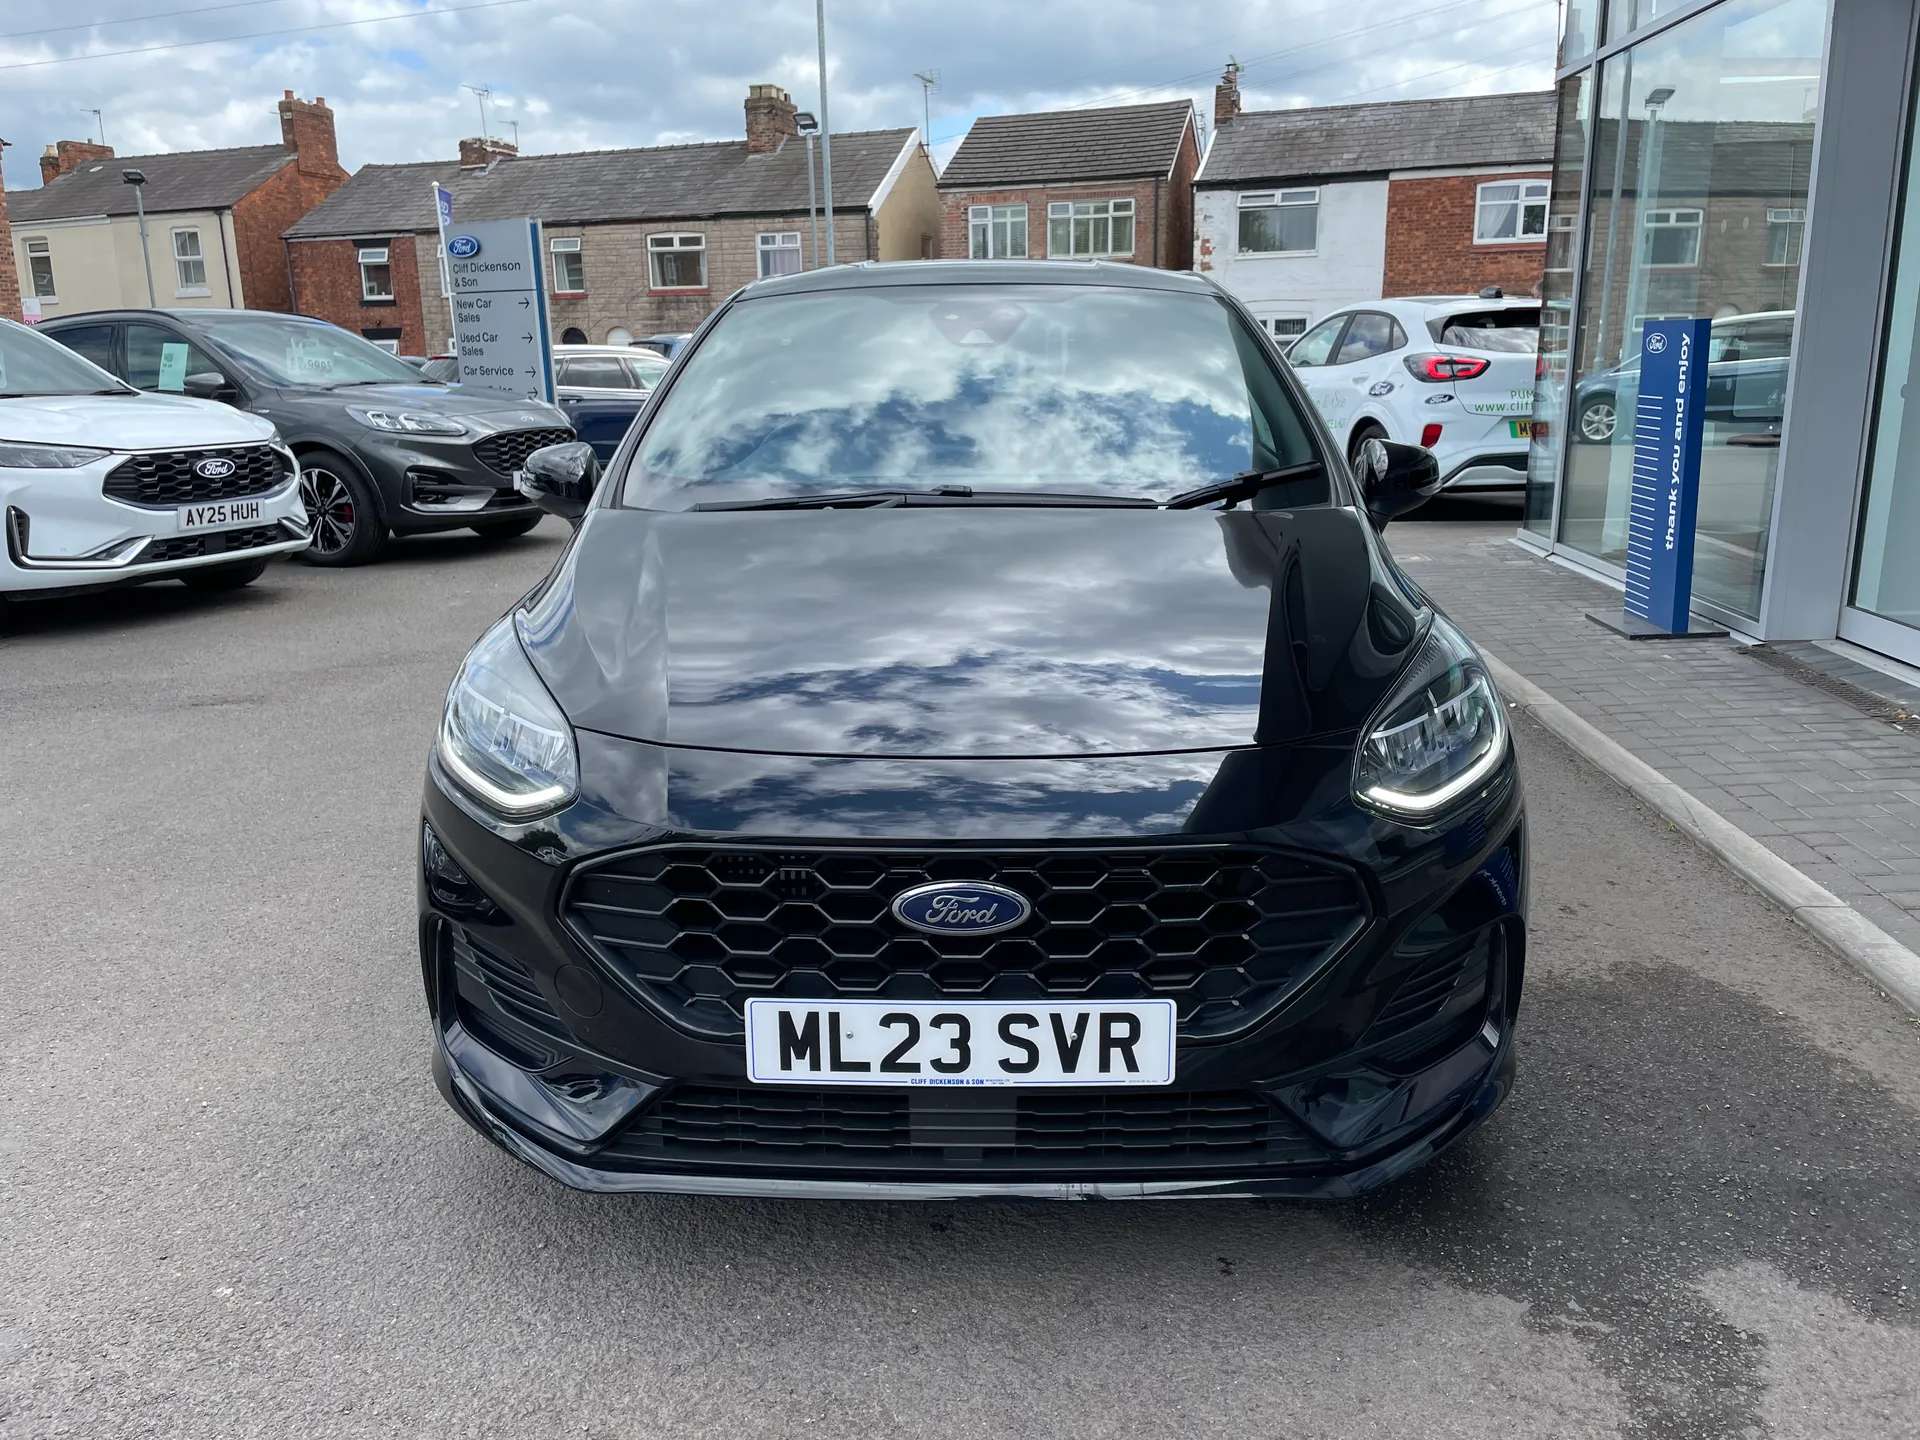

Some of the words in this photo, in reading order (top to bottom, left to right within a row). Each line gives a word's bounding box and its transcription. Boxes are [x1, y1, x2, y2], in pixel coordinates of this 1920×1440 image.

[452, 262, 469, 274] Cliff
[470, 260, 521, 273] Dickenson
[454, 277, 460, 287] &
[461, 276, 478, 287] Son
[456, 300, 475, 309] New
[476, 298, 492, 308] Car
[458, 313, 480, 323] Sales
[460, 333, 481, 343] Used
[482, 332, 498, 342] Car
[461, 346, 484, 356] Sales
[463, 366, 478, 376] Car
[479, 365, 515, 376] Service
[1677, 332, 1691, 395] enjoy
[1674, 398, 1685, 441] and
[1671, 444, 1681, 486] you
[186, 505, 226, 526] AY25
[231, 501, 259, 521] HUH
[1665, 487, 1678, 551] thank
[925, 895, 999, 925] Ford
[778, 1010, 972, 1073] ML23
[997, 1012, 1142, 1073] SVR
